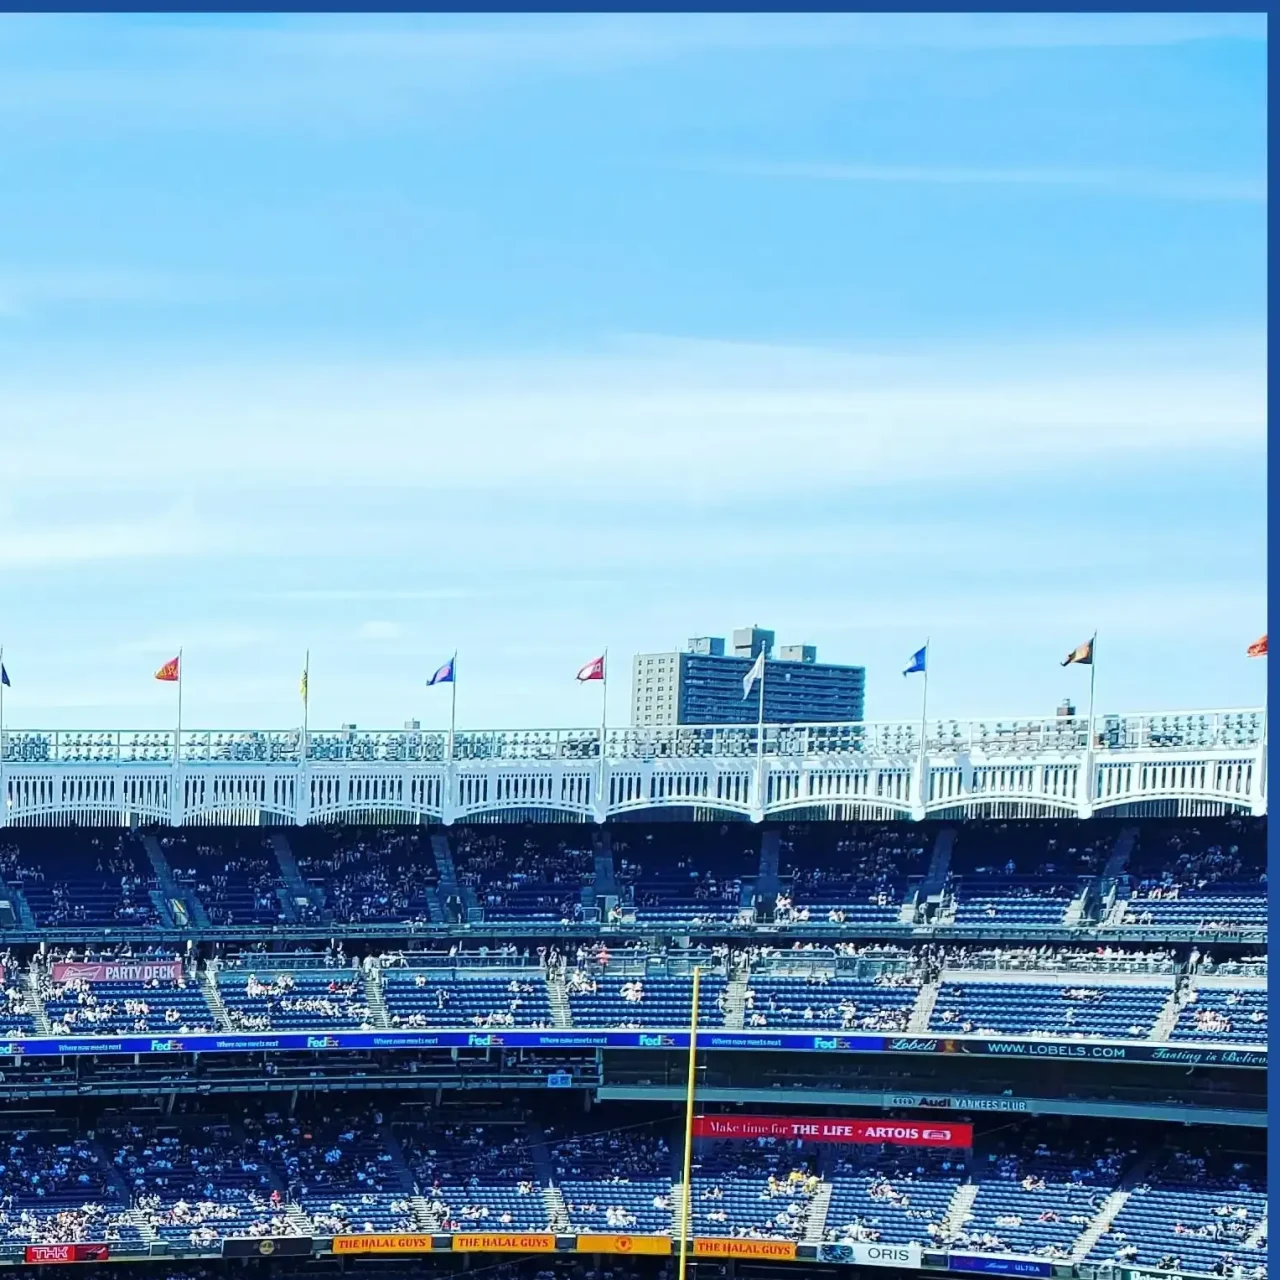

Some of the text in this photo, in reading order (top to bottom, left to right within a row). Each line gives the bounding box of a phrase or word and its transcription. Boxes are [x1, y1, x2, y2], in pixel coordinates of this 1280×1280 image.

[105, 966, 141, 980] PARTY
[144, 965, 175, 979] DECK
[151, 1040, 183, 1050] FedEx
[307, 1036, 339, 1048] FedEx
[468, 1034, 504, 1045] FedEx
[639, 1034, 675, 1046] FedEx
[813, 1037, 850, 1048] FedEx
[988, 1043, 1125, 1058] WWW.LOBELS.COM
[918, 1097, 1027, 1111] Audi YANKEES CLUB
[710, 1121, 739, 1133] Make
[742, 1122, 768, 1134] time
[771, 1123, 787, 1135] for
[791, 1124, 820, 1135] THE
[823, 1124, 853, 1136] LIFE
[864, 1127, 919, 1139] ARTOIS
[339, 1238, 426, 1249] THE HALAL GUYS
[459, 1239, 549, 1248] THE HALAL GUYS
[699, 1242, 791, 1255] THE HALAL GUYS
[31, 1246, 69, 1258] THK
[868, 1247, 909, 1261] ORIS
